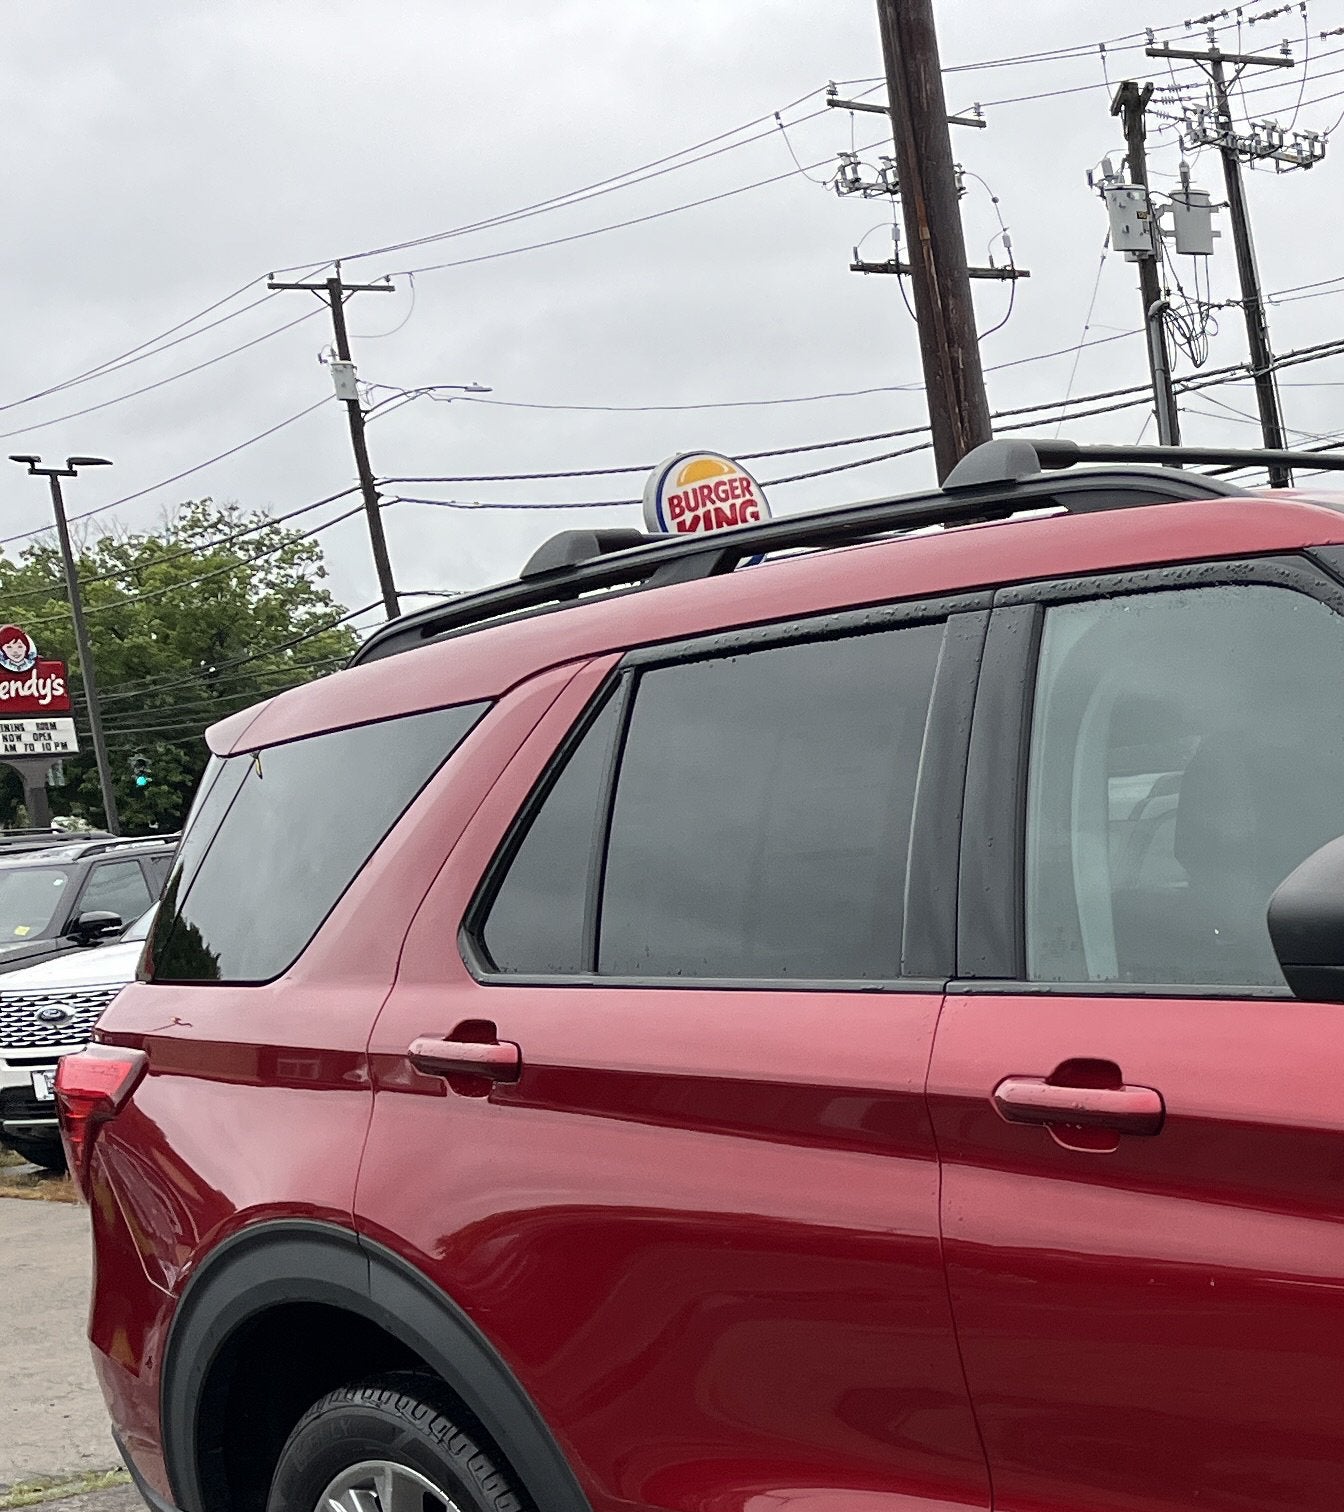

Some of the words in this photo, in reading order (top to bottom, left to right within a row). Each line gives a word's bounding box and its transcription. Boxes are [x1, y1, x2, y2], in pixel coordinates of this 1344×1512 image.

[667, 477, 753, 521] BURGER
[0, 669, 64, 705] endy's
[2, 733, 22, 743] NOW
[24, 742, 35, 752] TO
[54, 742, 68, 750] PM
